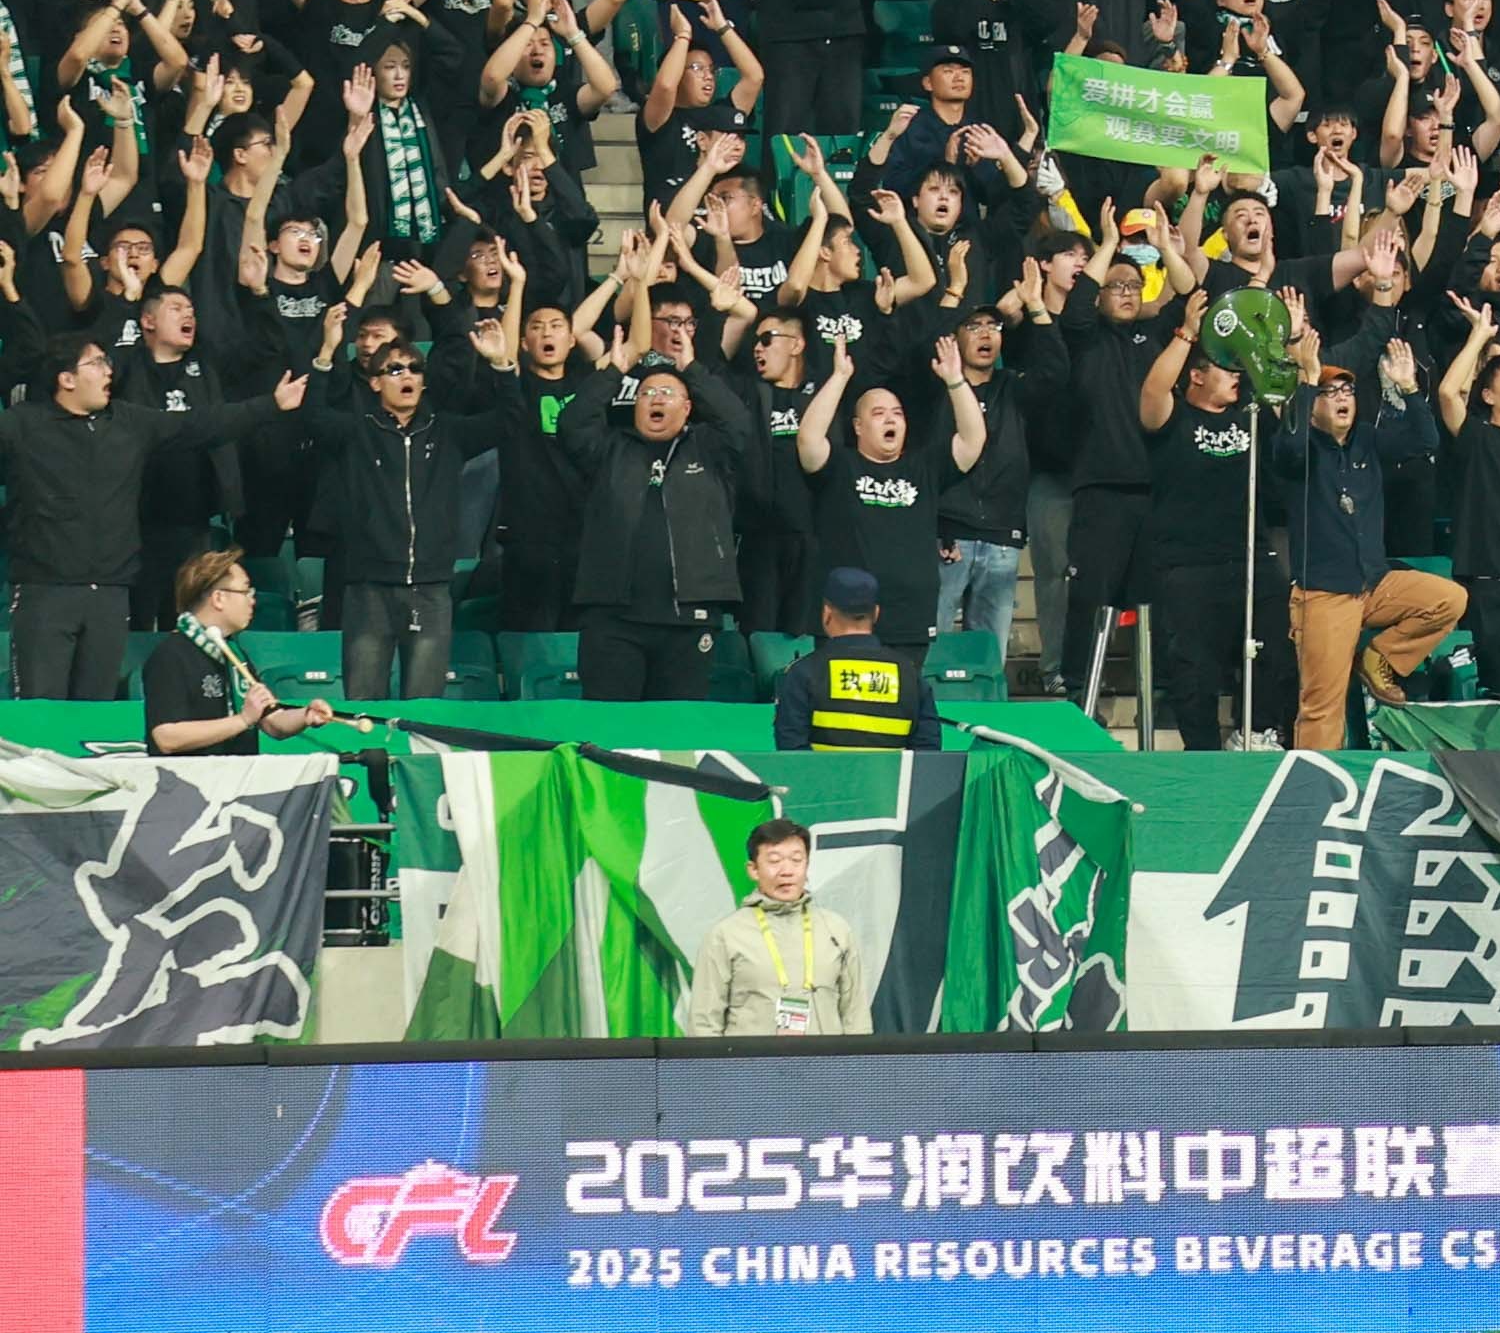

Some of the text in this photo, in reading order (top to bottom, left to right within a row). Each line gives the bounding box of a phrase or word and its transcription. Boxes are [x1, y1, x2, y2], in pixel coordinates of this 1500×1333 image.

[1079, 72, 1215, 120] 爱拼才会赢
[1103, 112, 1242, 157] 观赛要文明
[839, 669, 891, 695] 执勤
[567, 1246, 683, 1289] 2025
[702, 1243, 856, 1283] CHINA
[874, 1234, 1157, 1281] RESOURCES
[1174, 1231, 1425, 1273] BEVERAGE
